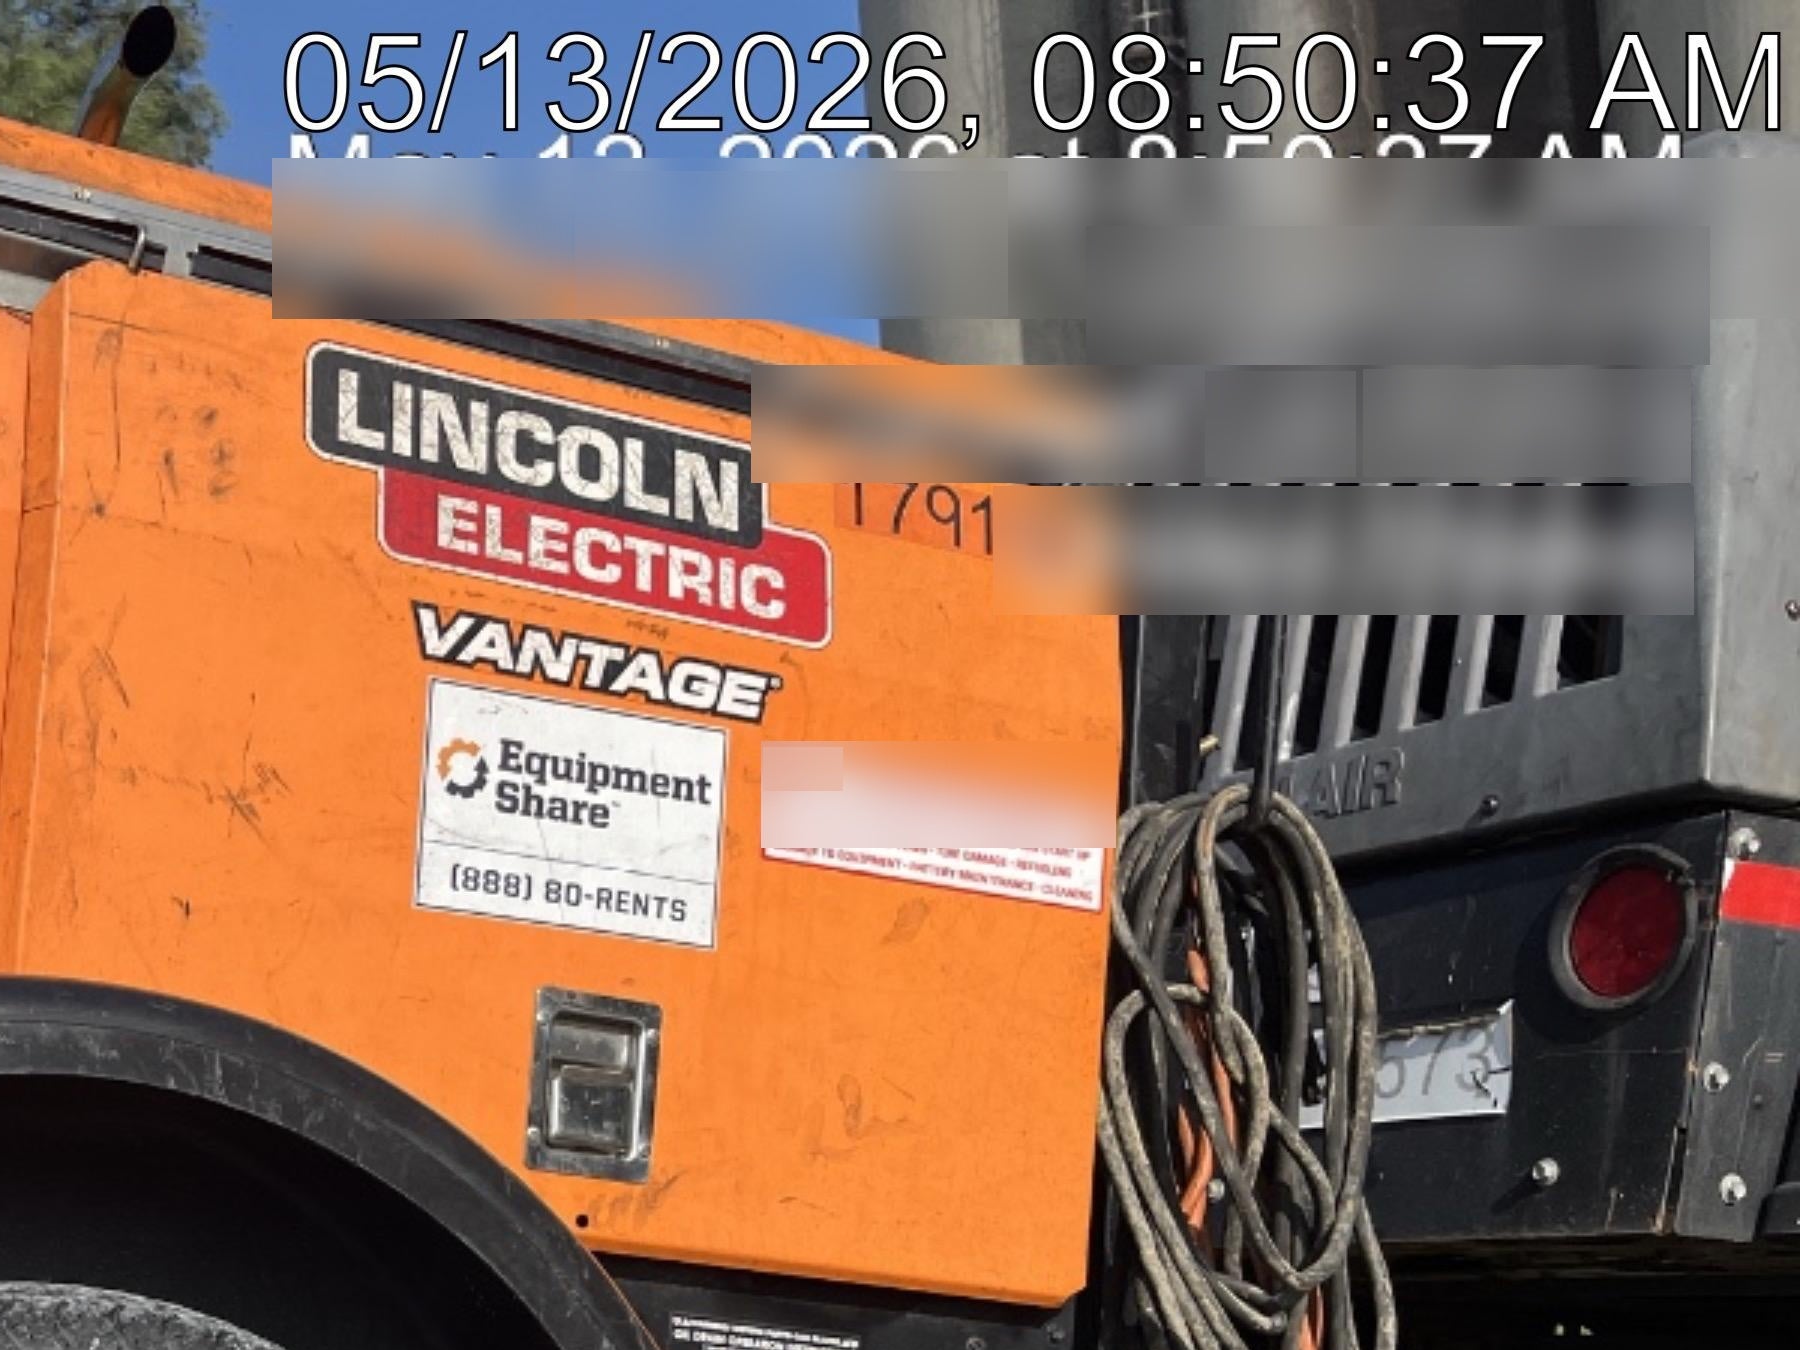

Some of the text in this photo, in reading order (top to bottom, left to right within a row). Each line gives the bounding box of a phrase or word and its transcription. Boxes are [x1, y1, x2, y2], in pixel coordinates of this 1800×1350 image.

[338, 368, 740, 532] LINCOLN
[438, 494, 786, 619] ELECTRIC
[414, 602, 770, 719] VANTAGE
[495, 780, 611, 829] Share
[498, 738, 712, 806] Equipment
[451, 863, 689, 923] (888) 80-RENTS
